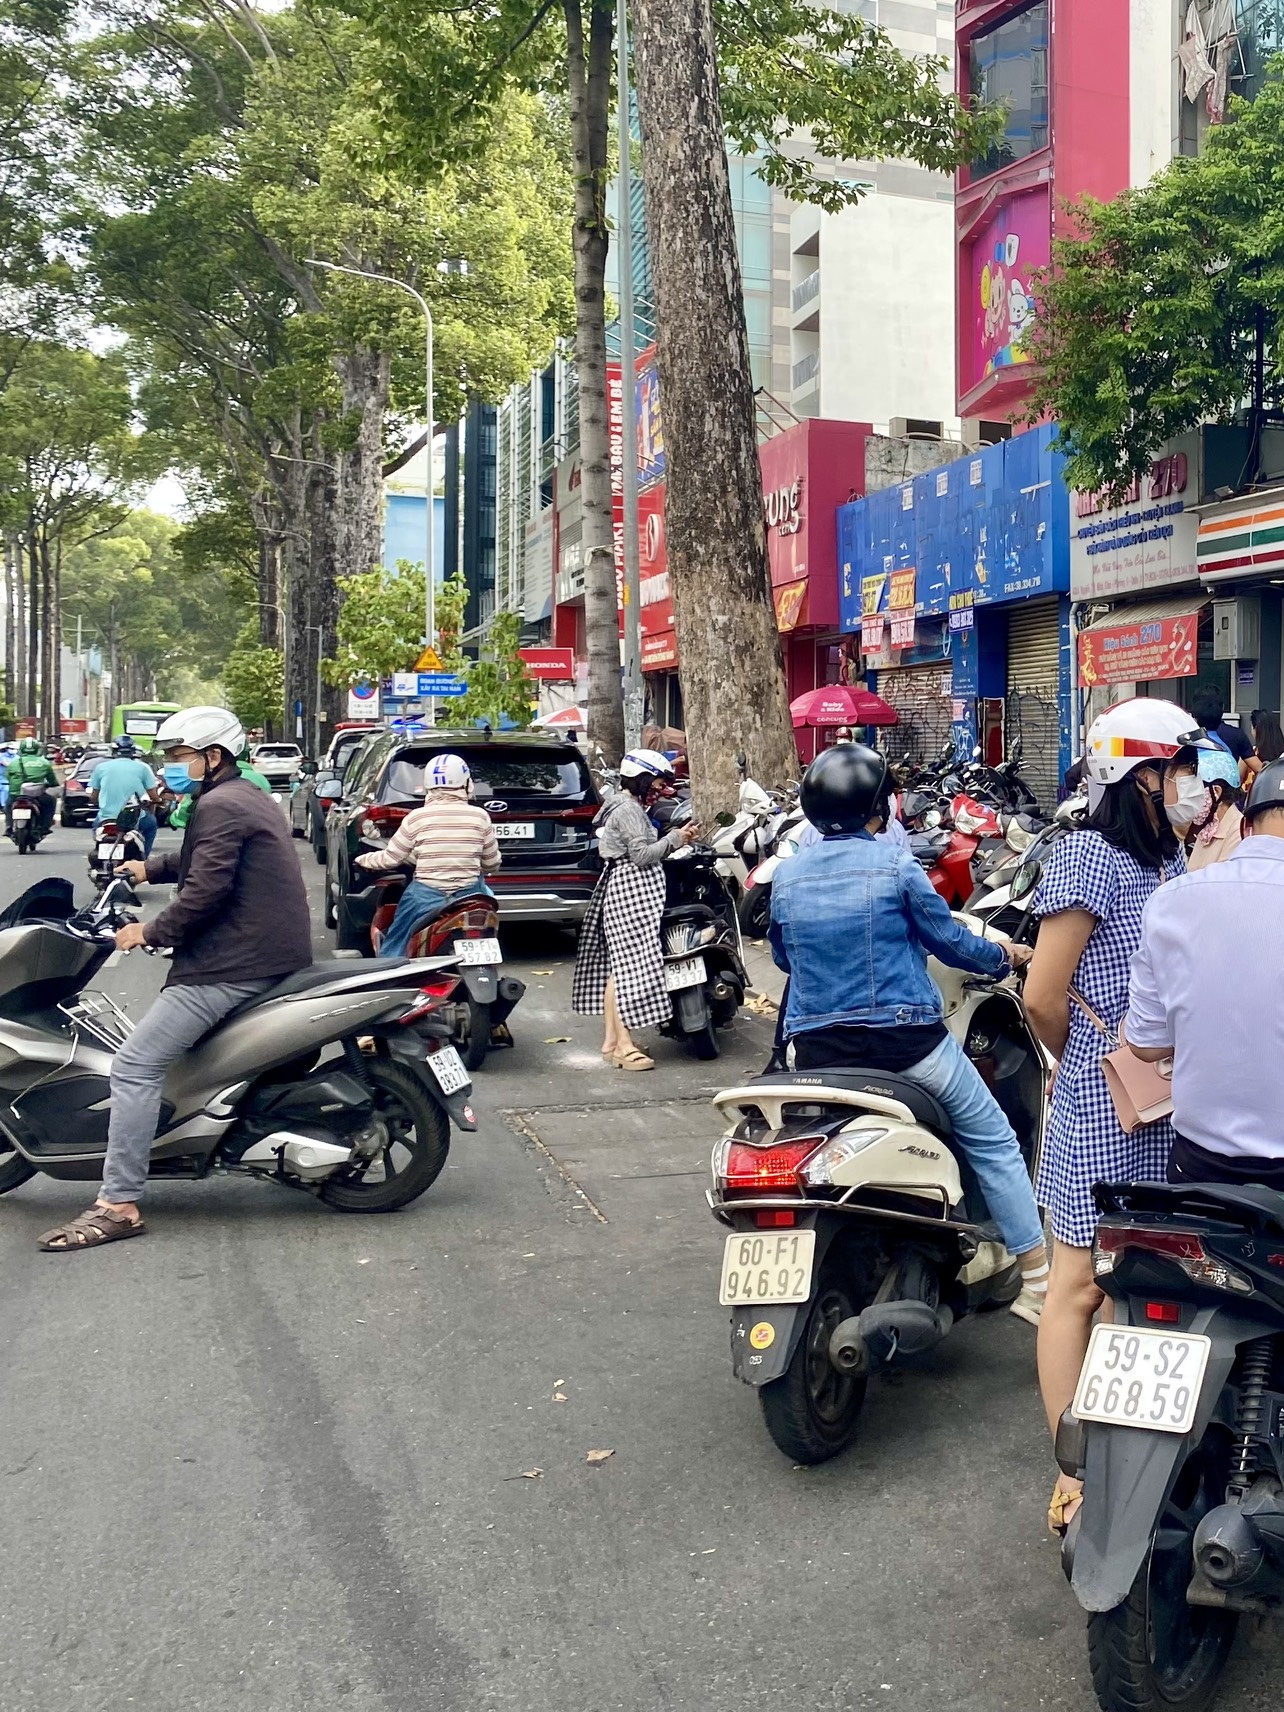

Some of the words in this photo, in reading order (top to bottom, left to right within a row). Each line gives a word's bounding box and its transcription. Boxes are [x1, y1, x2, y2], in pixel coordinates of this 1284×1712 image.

[1140, 622, 1162, 645] 270
[493, 826, 528, 836] 66.41
[668, 959, 697, 976] 59-V1
[792, 1077, 823, 1085] YAMAHA
[739, 1236, 799, 1266] 60-F1
[727, 1267, 805, 1299] 946.92
[1104, 1333, 1190, 1379] 59-S2
[1083, 1374, 1190, 1424] 668.59
